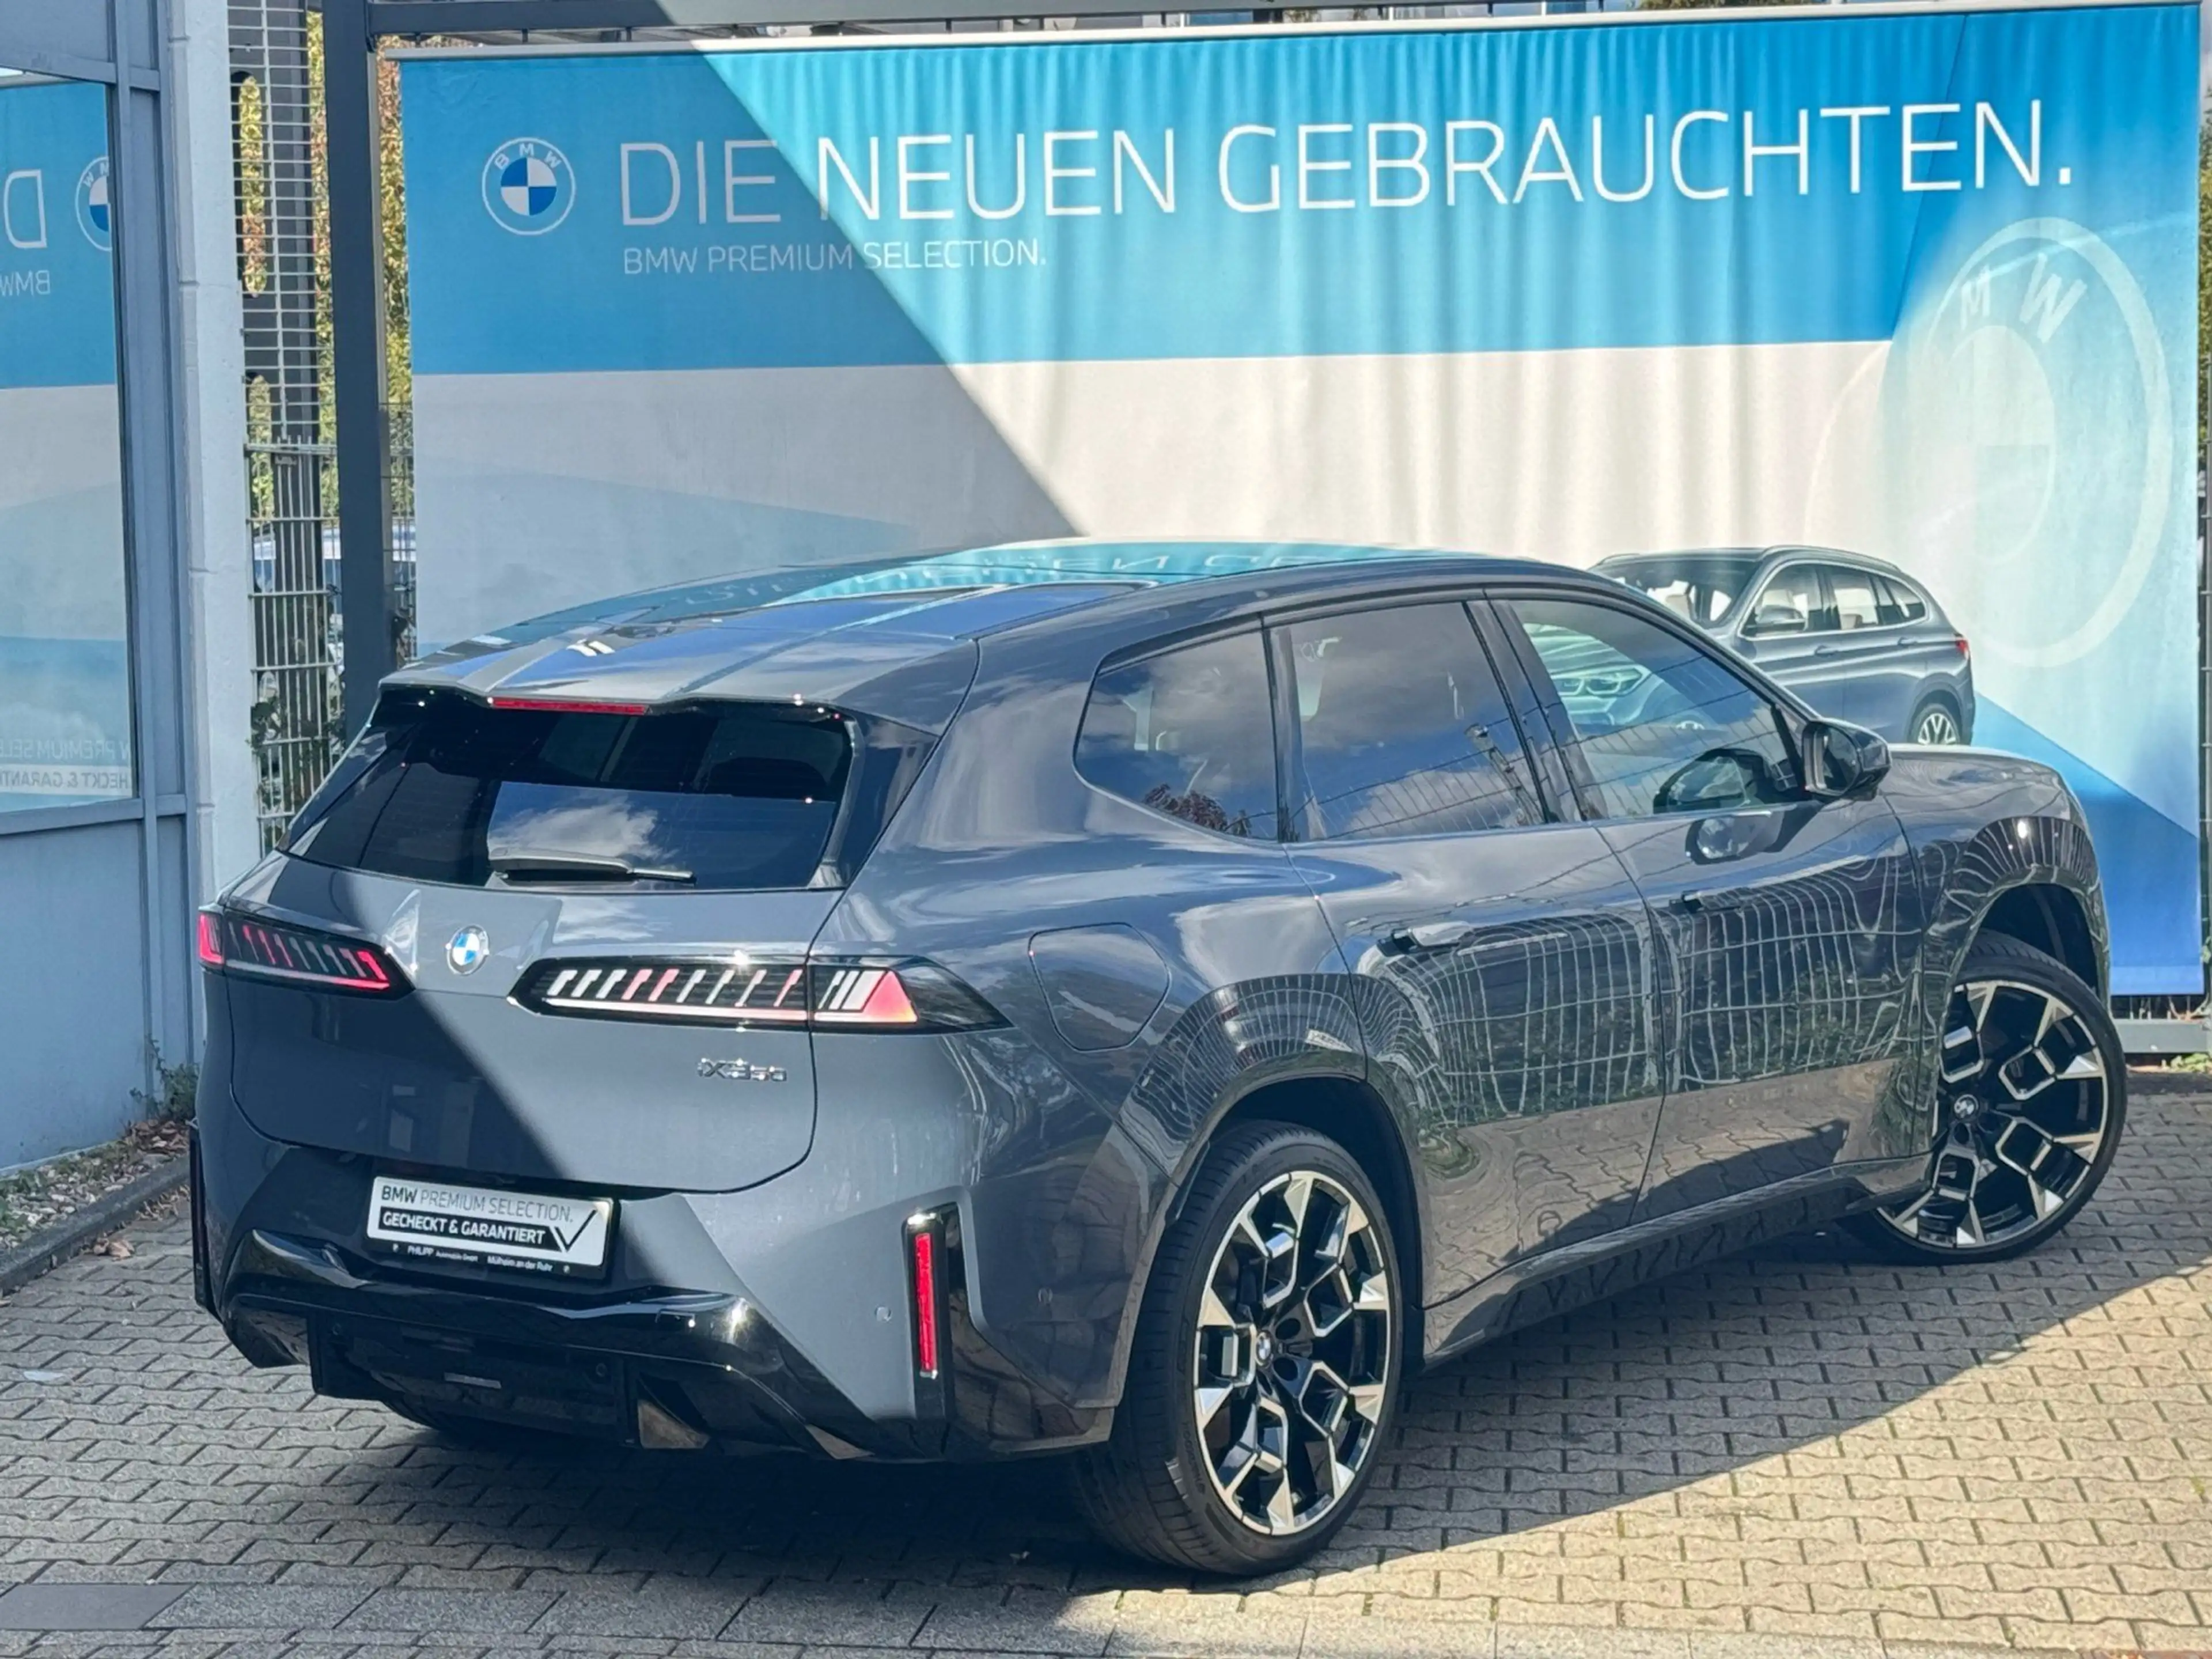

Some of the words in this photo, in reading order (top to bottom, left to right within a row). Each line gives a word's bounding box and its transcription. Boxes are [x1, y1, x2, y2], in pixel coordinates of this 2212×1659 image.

[494, 143, 562, 170] BMW
[620, 140, 781, 226] DIE
[818, 128, 1176, 221] NEUEN
[1218, 99, 2071, 213] GEBRAUCHTEN.
[623, 247, 698, 275] BMW
[707, 244, 853, 272] PREMIUM
[864, 237, 1047, 269] SELECTION.
[381, 1185, 418, 1204] BMW
[420, 1189, 485, 1212] PREMIUM
[488, 1197, 574, 1223] SELECTION.
[382, 1211, 448, 1233] GECHECKT
[449, 1219, 459, 1234] &
[461, 1221, 546, 1244] GARANTIERT
